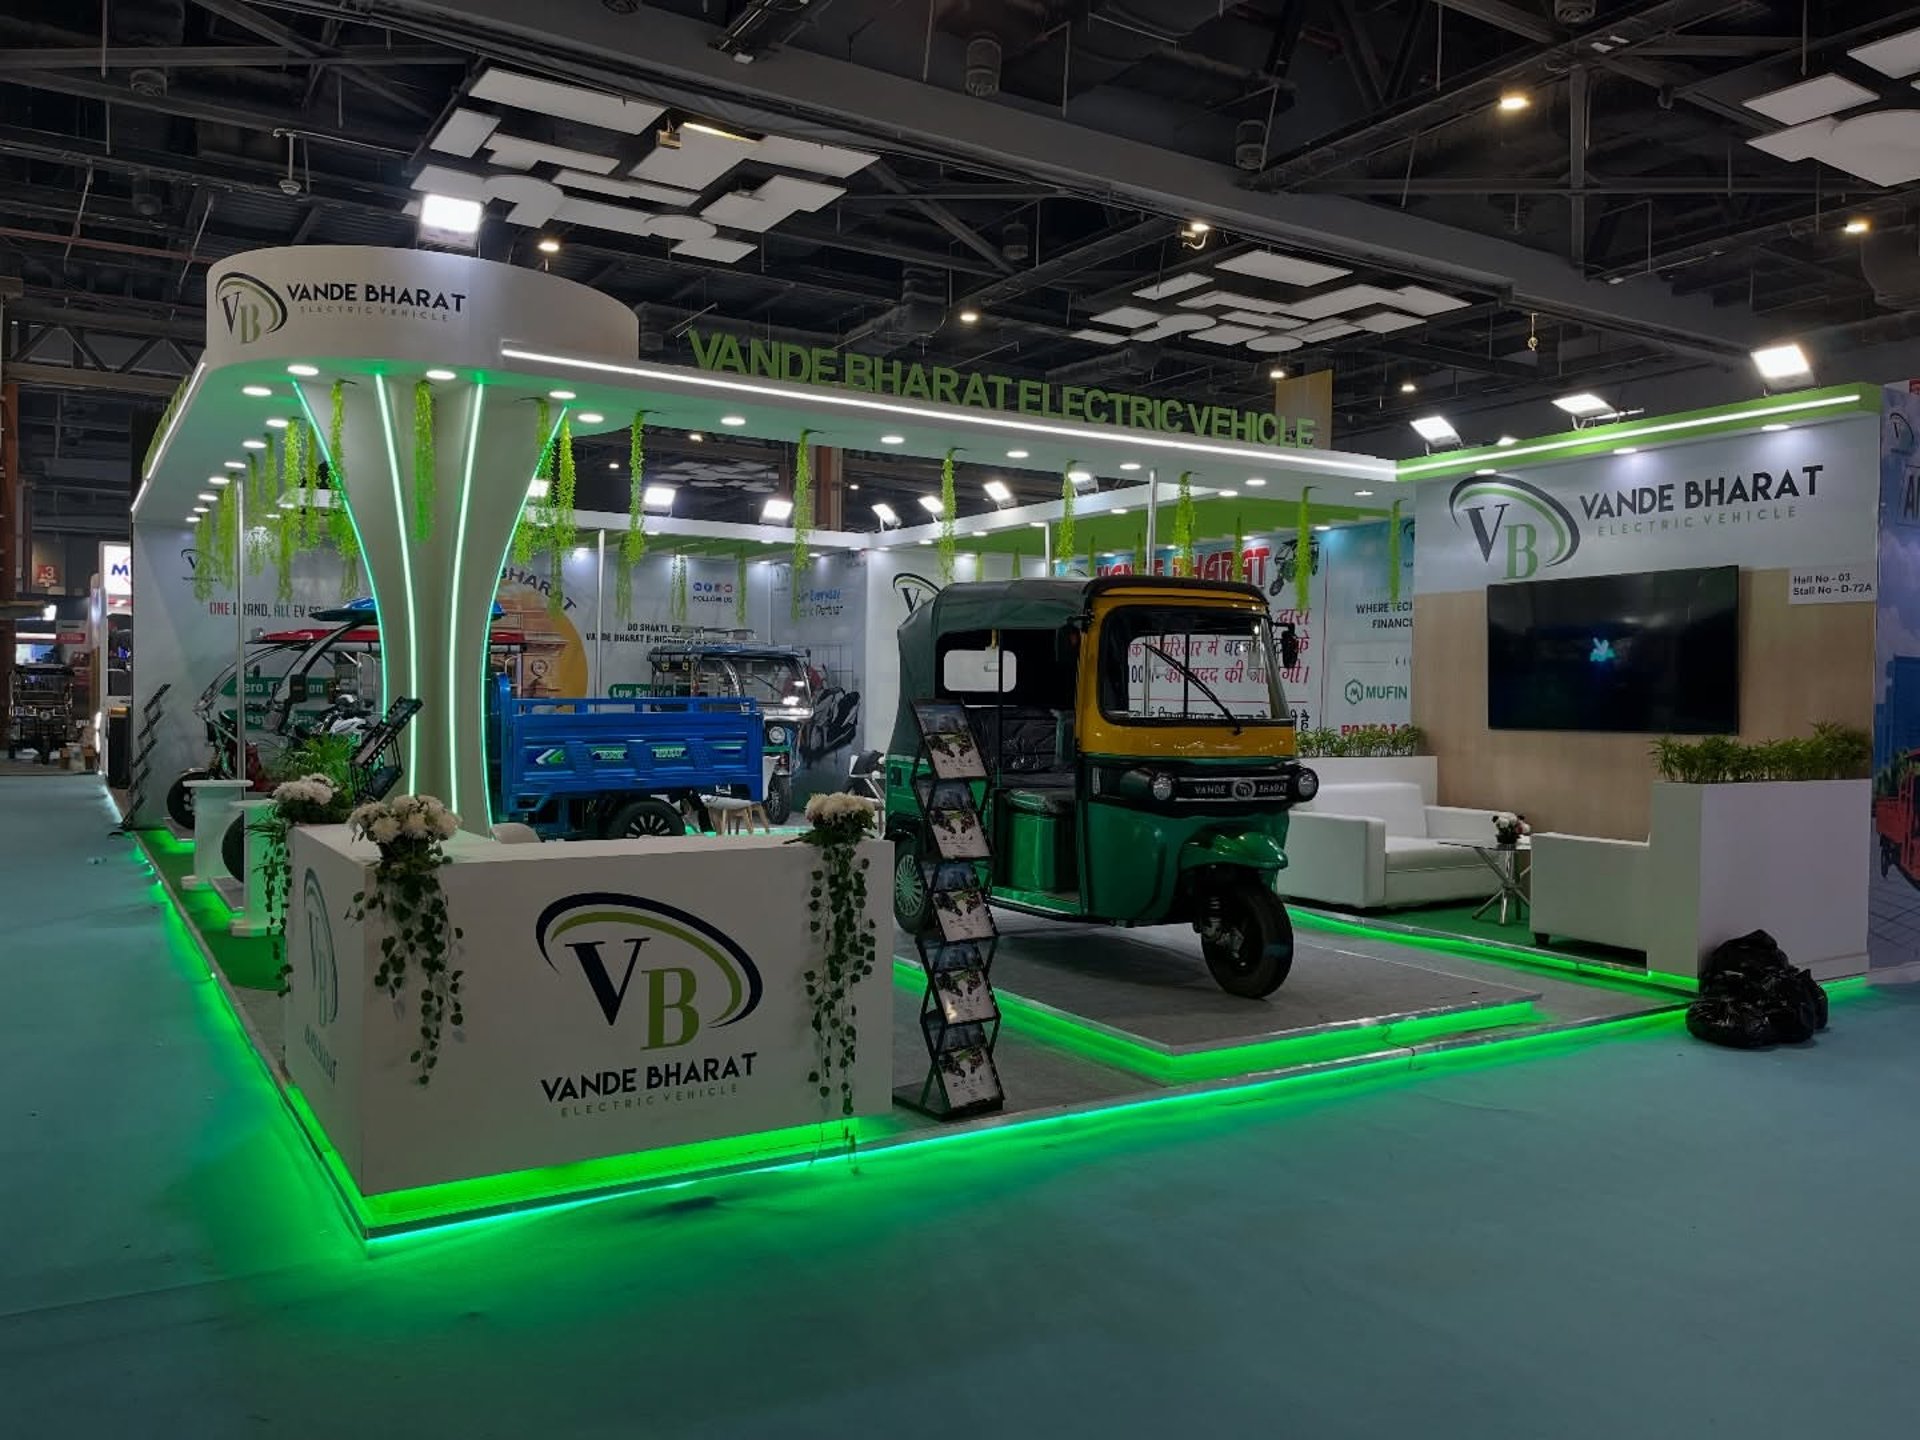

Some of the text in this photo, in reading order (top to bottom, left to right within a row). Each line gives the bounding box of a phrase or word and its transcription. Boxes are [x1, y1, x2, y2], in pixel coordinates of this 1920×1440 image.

[287, 283, 466, 312] VANDE BHARAT
[301, 306, 448, 322] ELECTRIC VEHICLE
[689, 331, 1316, 449] VANDE BHARAT ELECTRIC VEHICLE
[1580, 465, 1823, 521] VANDE BHARAT
[1599, 506, 1796, 536] ELECTRIC VEHICLE
[1793, 575, 1813, 585] Hall
[1815, 574, 1829, 583] No
[1838, 572, 1851, 582] 03
[1793, 586, 1815, 596] Stall
[1817, 585, 1832, 594] No
[1841, 584, 1872, 593] D-72A
[209, 602, 230, 616] ONE
[1356, 603, 1389, 614] WHERE
[236, 681, 263, 694] ero
[1366, 686, 1408, 700] MUFIN
[541, 1052, 758, 1102] VANDE BHARAT
[561, 1083, 737, 1117] ELECTRIC VEHICLE
